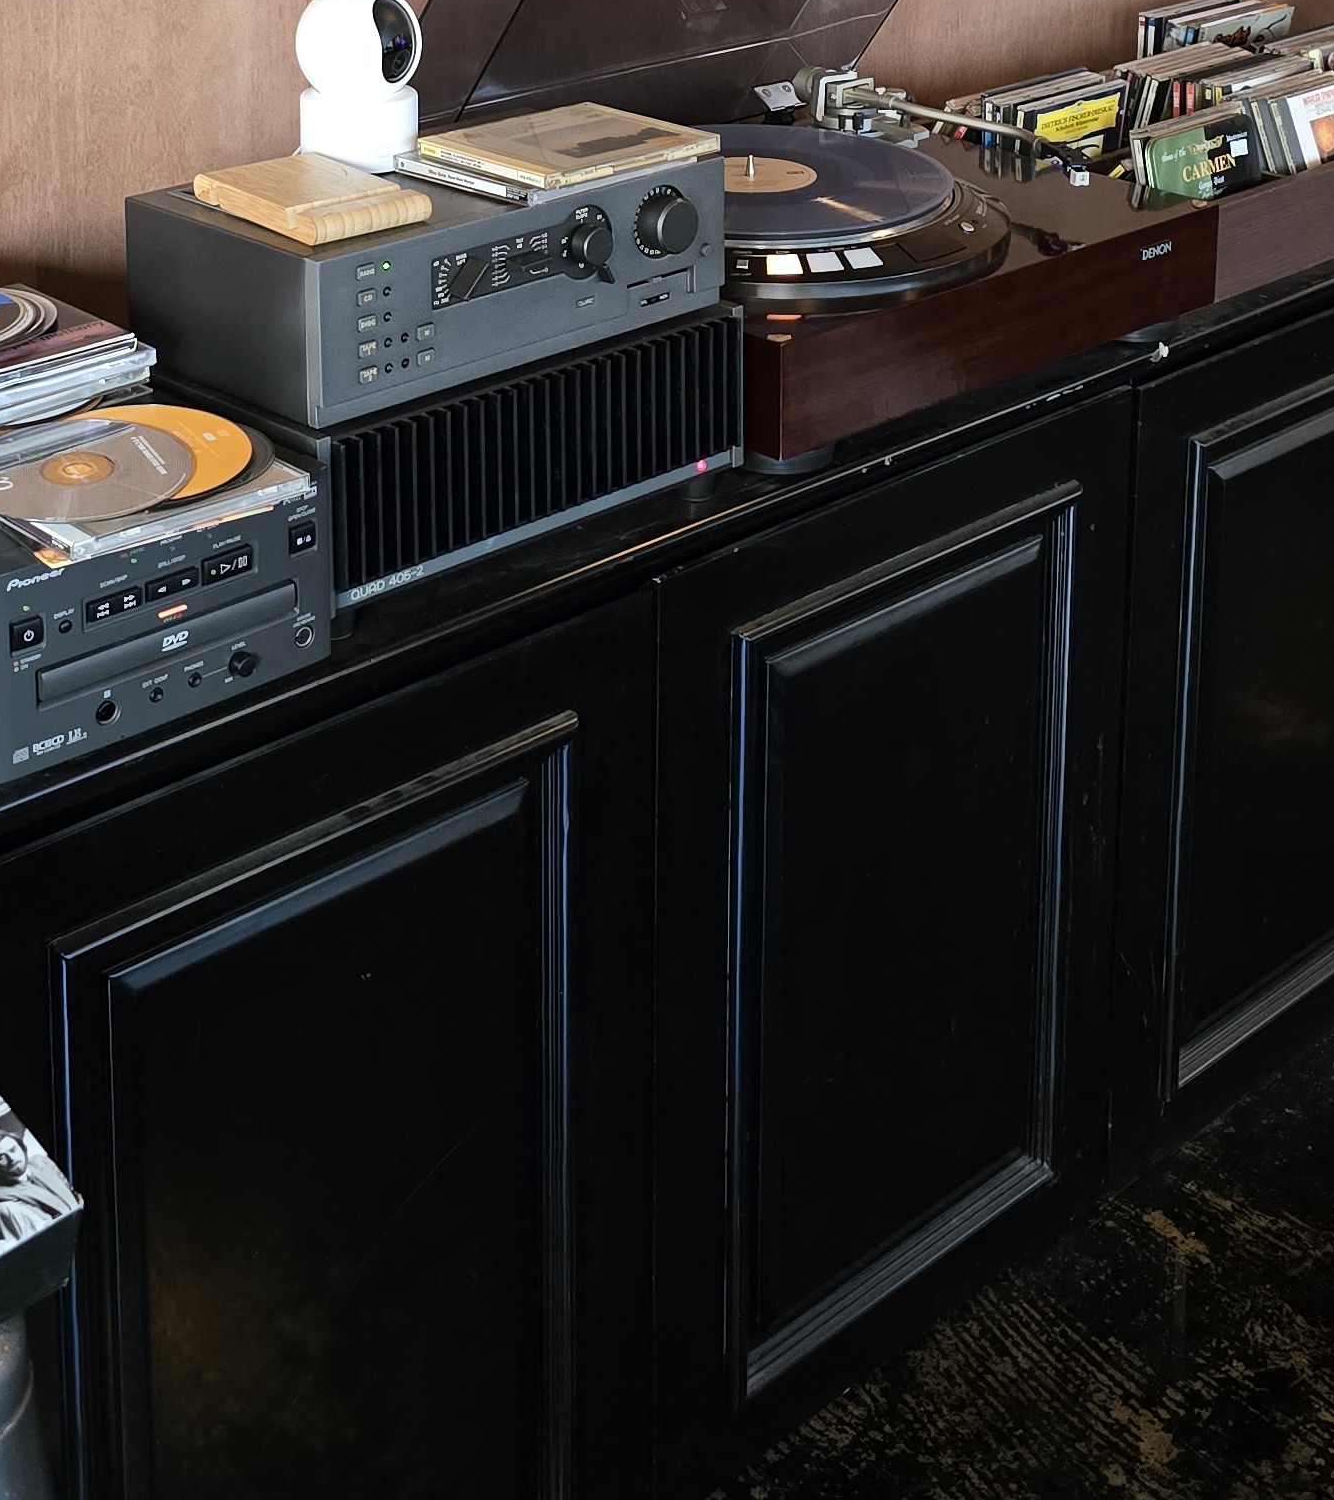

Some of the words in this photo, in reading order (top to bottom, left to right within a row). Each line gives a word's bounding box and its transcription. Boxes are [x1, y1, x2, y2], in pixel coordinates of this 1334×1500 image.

[1182, 153, 1237, 183] CARMEN
[1142, 241, 1172, 261] DENON
[364, 294, 373, 302] CD
[360, 319, 376, 328] DISC
[7, 568, 65, 591] Pioneer
[351, 580, 385, 601] QUAD
[389, 565, 425, 586] 405-2
[54, 608, 74, 619] DISPLAY
[163, 631, 188, 647] DVD
[231, 641, 246, 651] LEVEL
[184, 661, 204, 672] PHONES
